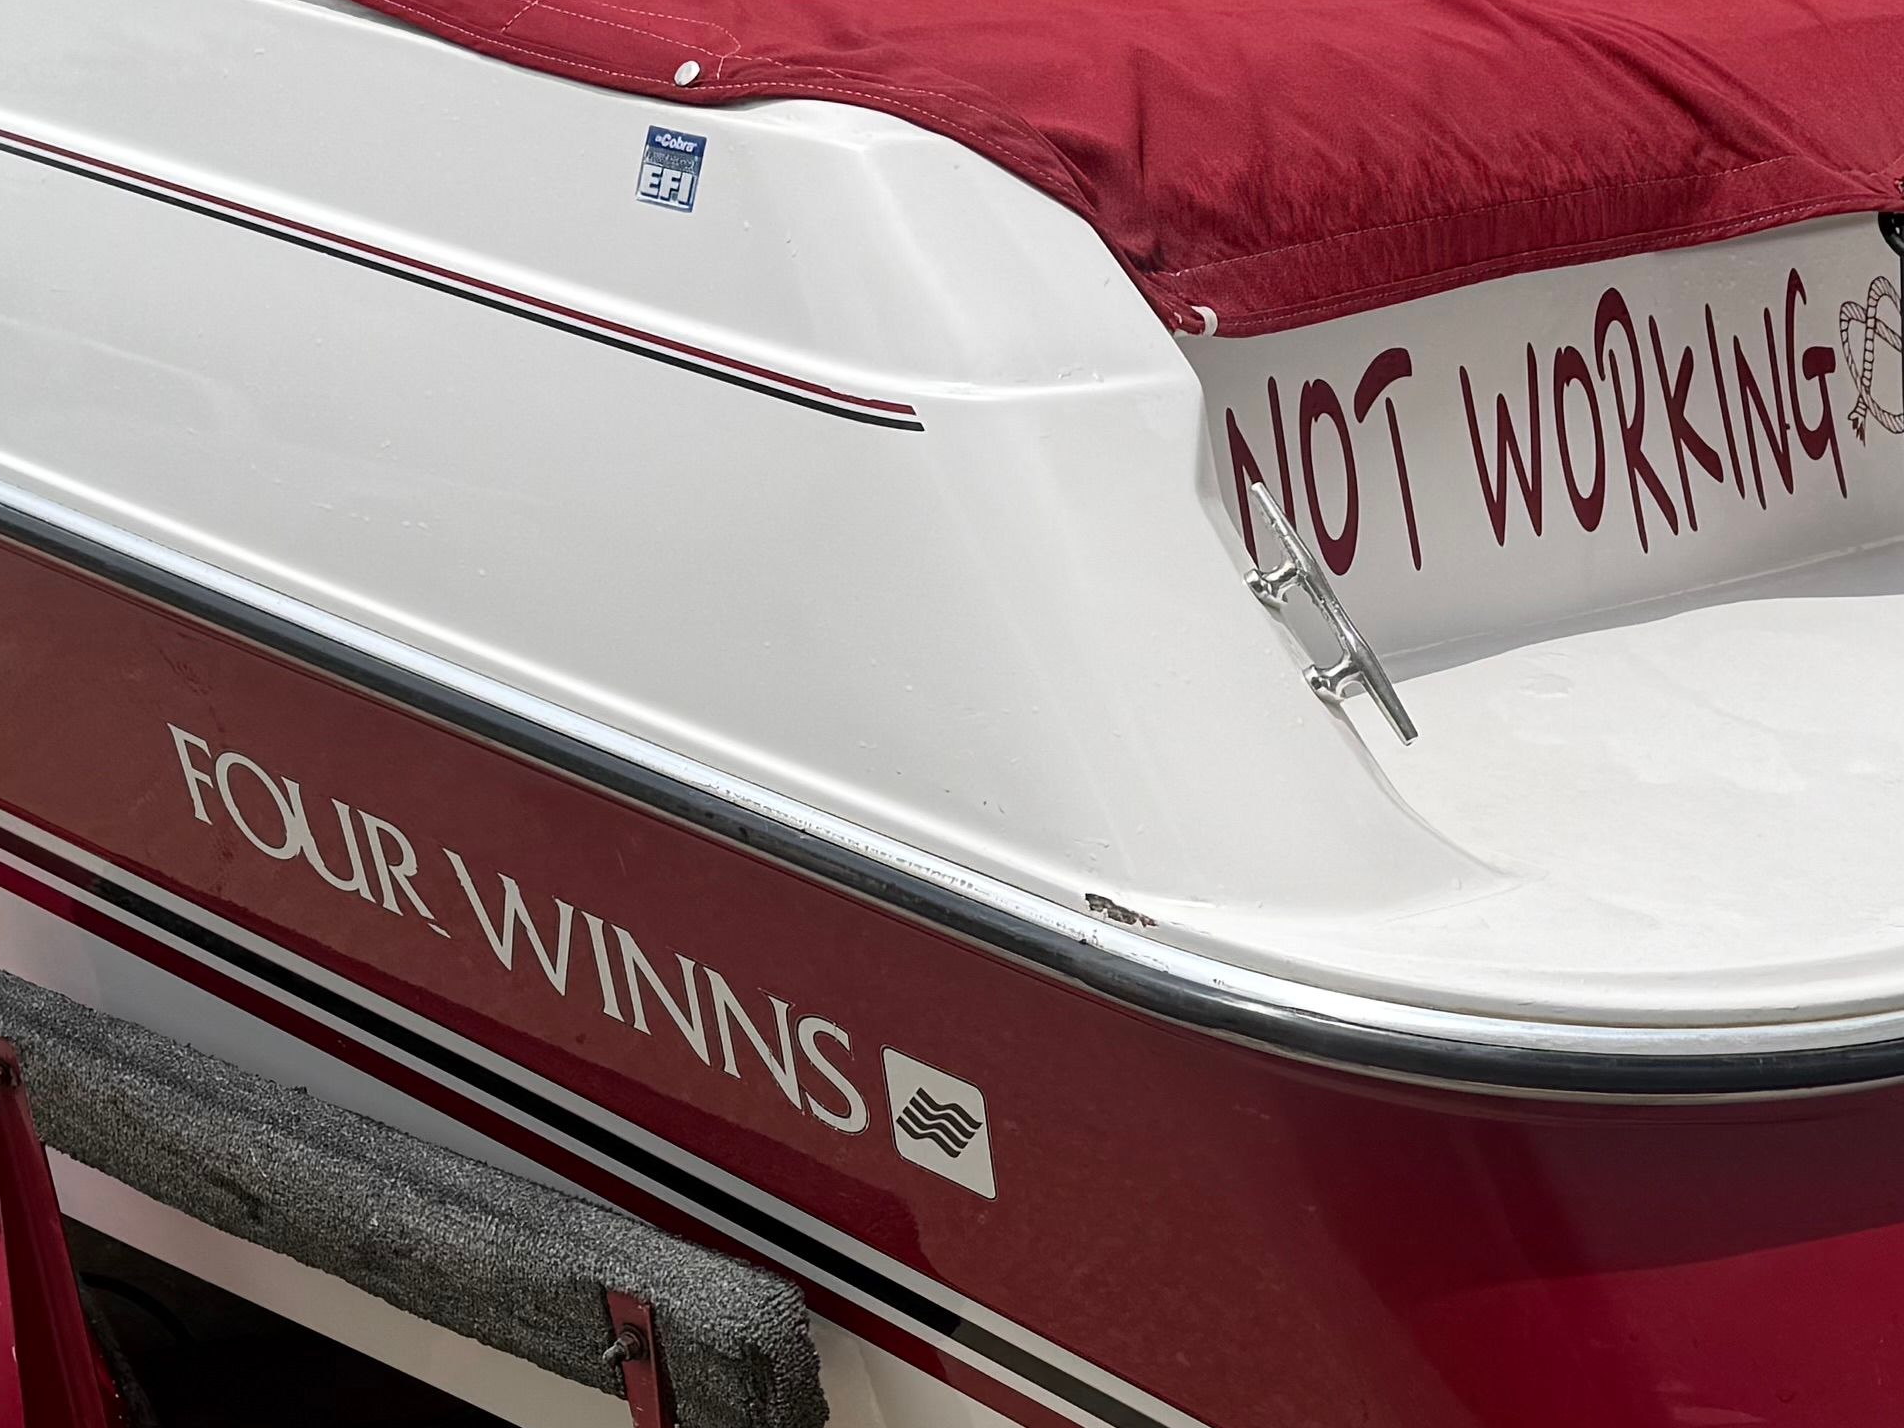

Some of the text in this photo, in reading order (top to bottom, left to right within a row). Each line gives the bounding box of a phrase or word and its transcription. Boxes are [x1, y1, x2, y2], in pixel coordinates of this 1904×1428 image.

[639, 164, 694, 205] EFI
[661, 133, 697, 153] Cobra
[1226, 267, 1848, 576] NOT WORKING
[167, 723, 869, 1135] FOUR WINNS
